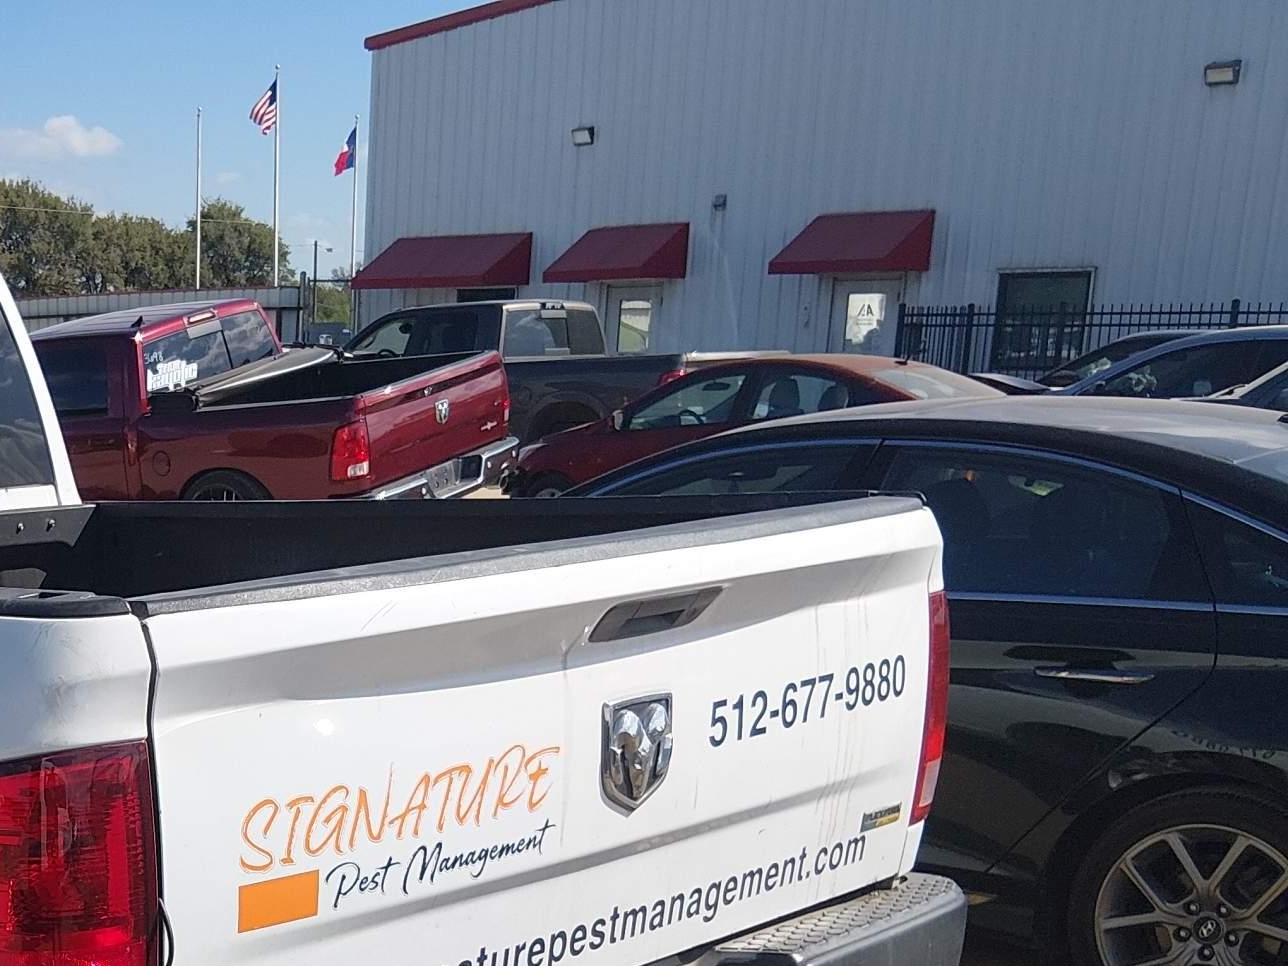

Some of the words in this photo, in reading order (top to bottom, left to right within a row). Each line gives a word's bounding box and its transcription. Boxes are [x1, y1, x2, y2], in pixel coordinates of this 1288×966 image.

[710, 655, 905, 747] 512-677-9880
[239, 745, 559, 872] SIGNATURE
[325, 856, 401, 908] Pest
[402, 818, 556, 895] Management
